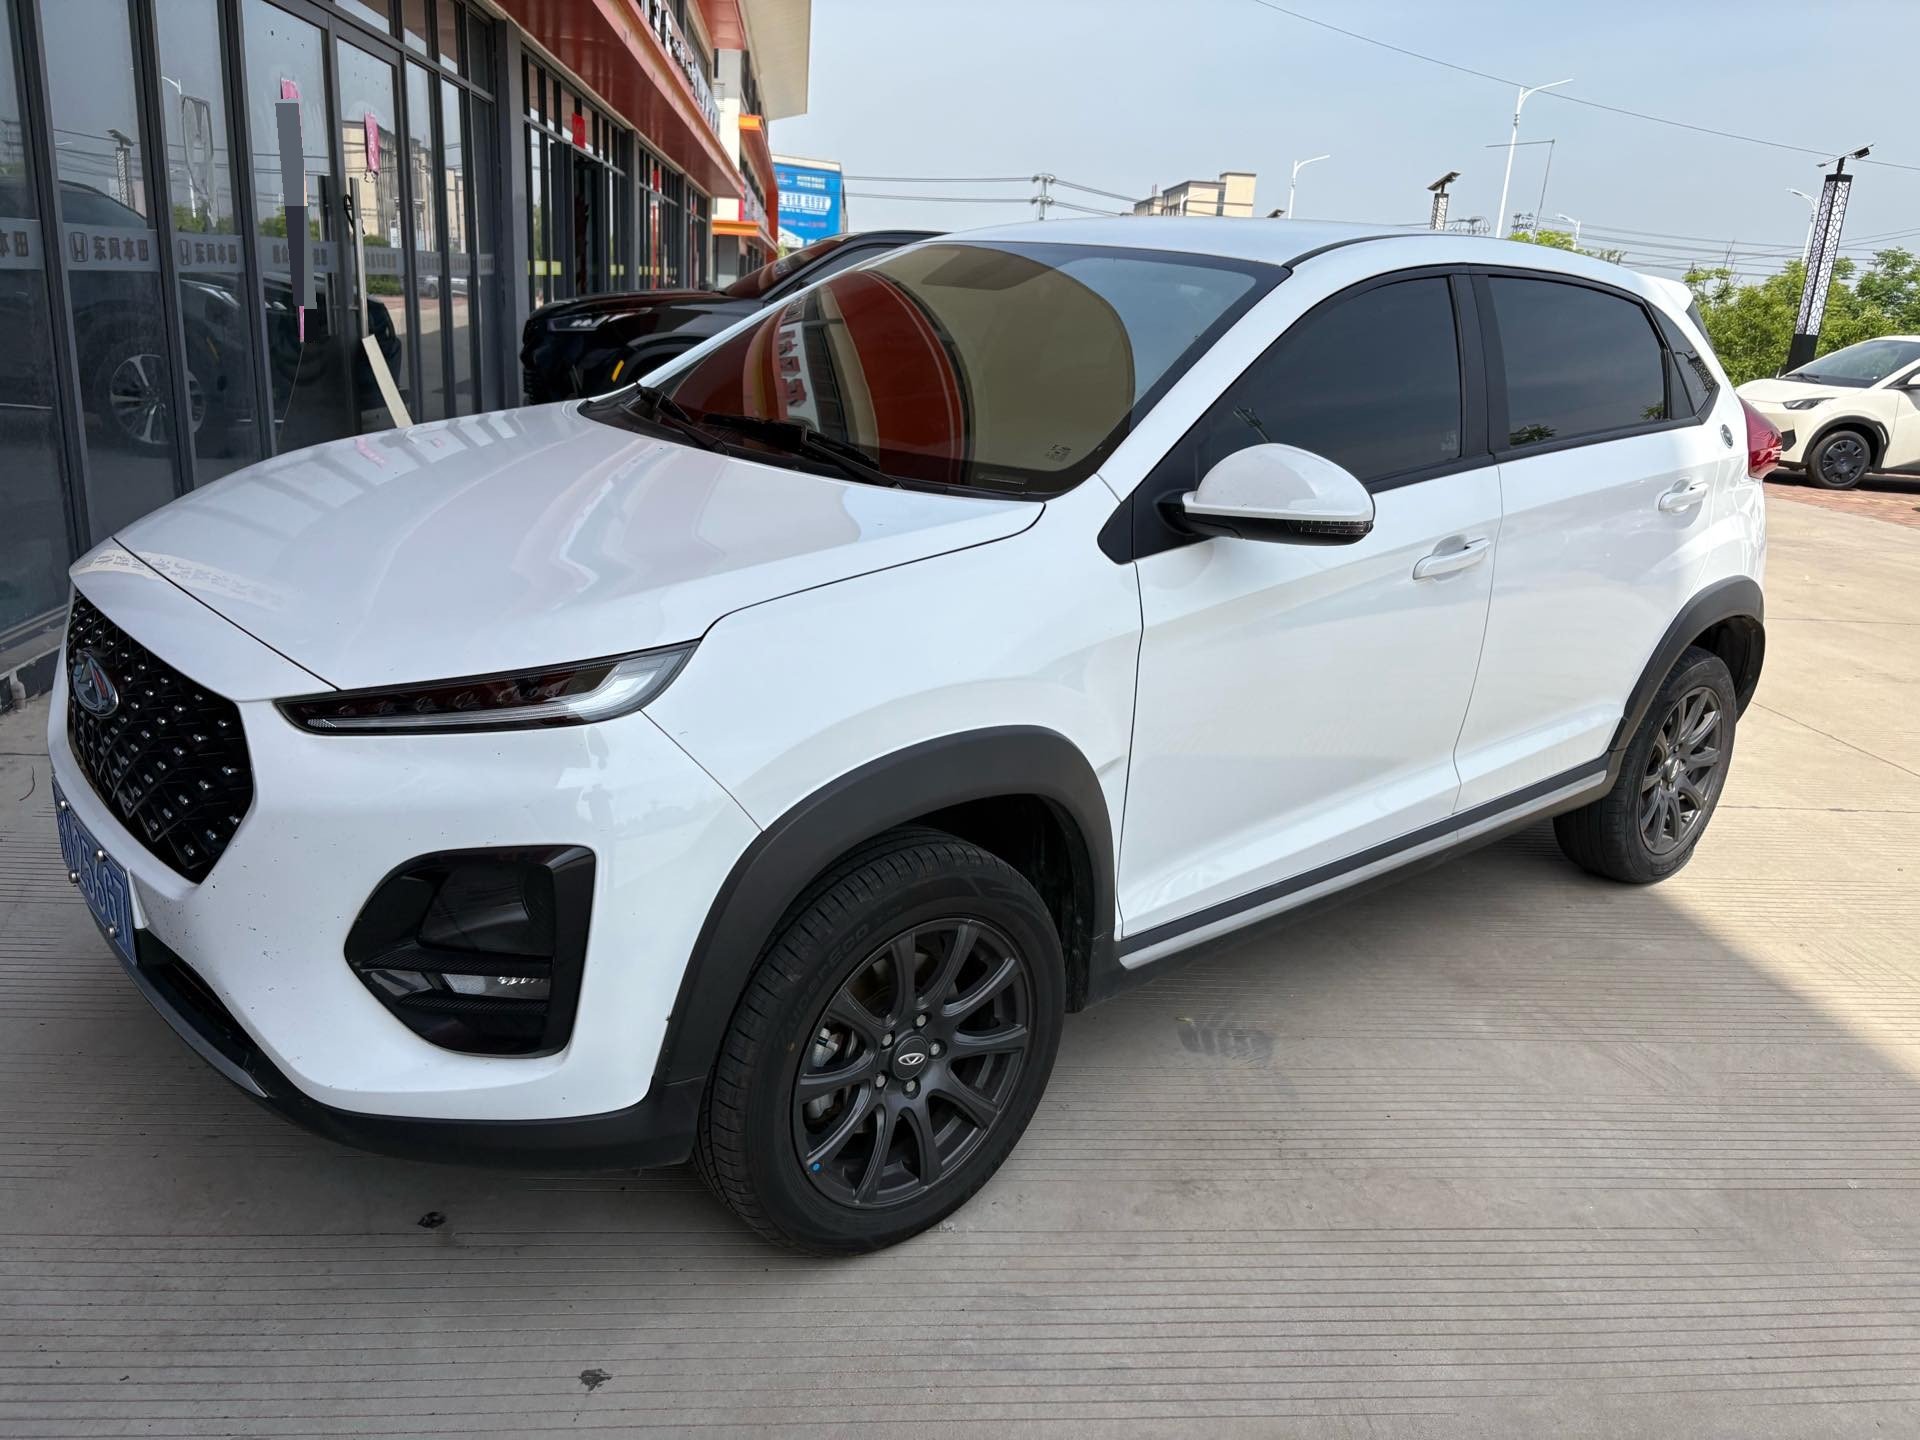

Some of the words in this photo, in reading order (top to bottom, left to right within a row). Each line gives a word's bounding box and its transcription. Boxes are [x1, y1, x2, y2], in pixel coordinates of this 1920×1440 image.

[93, 235, 149, 261] 东风本田
[194, 242, 237, 264] 东风本田
